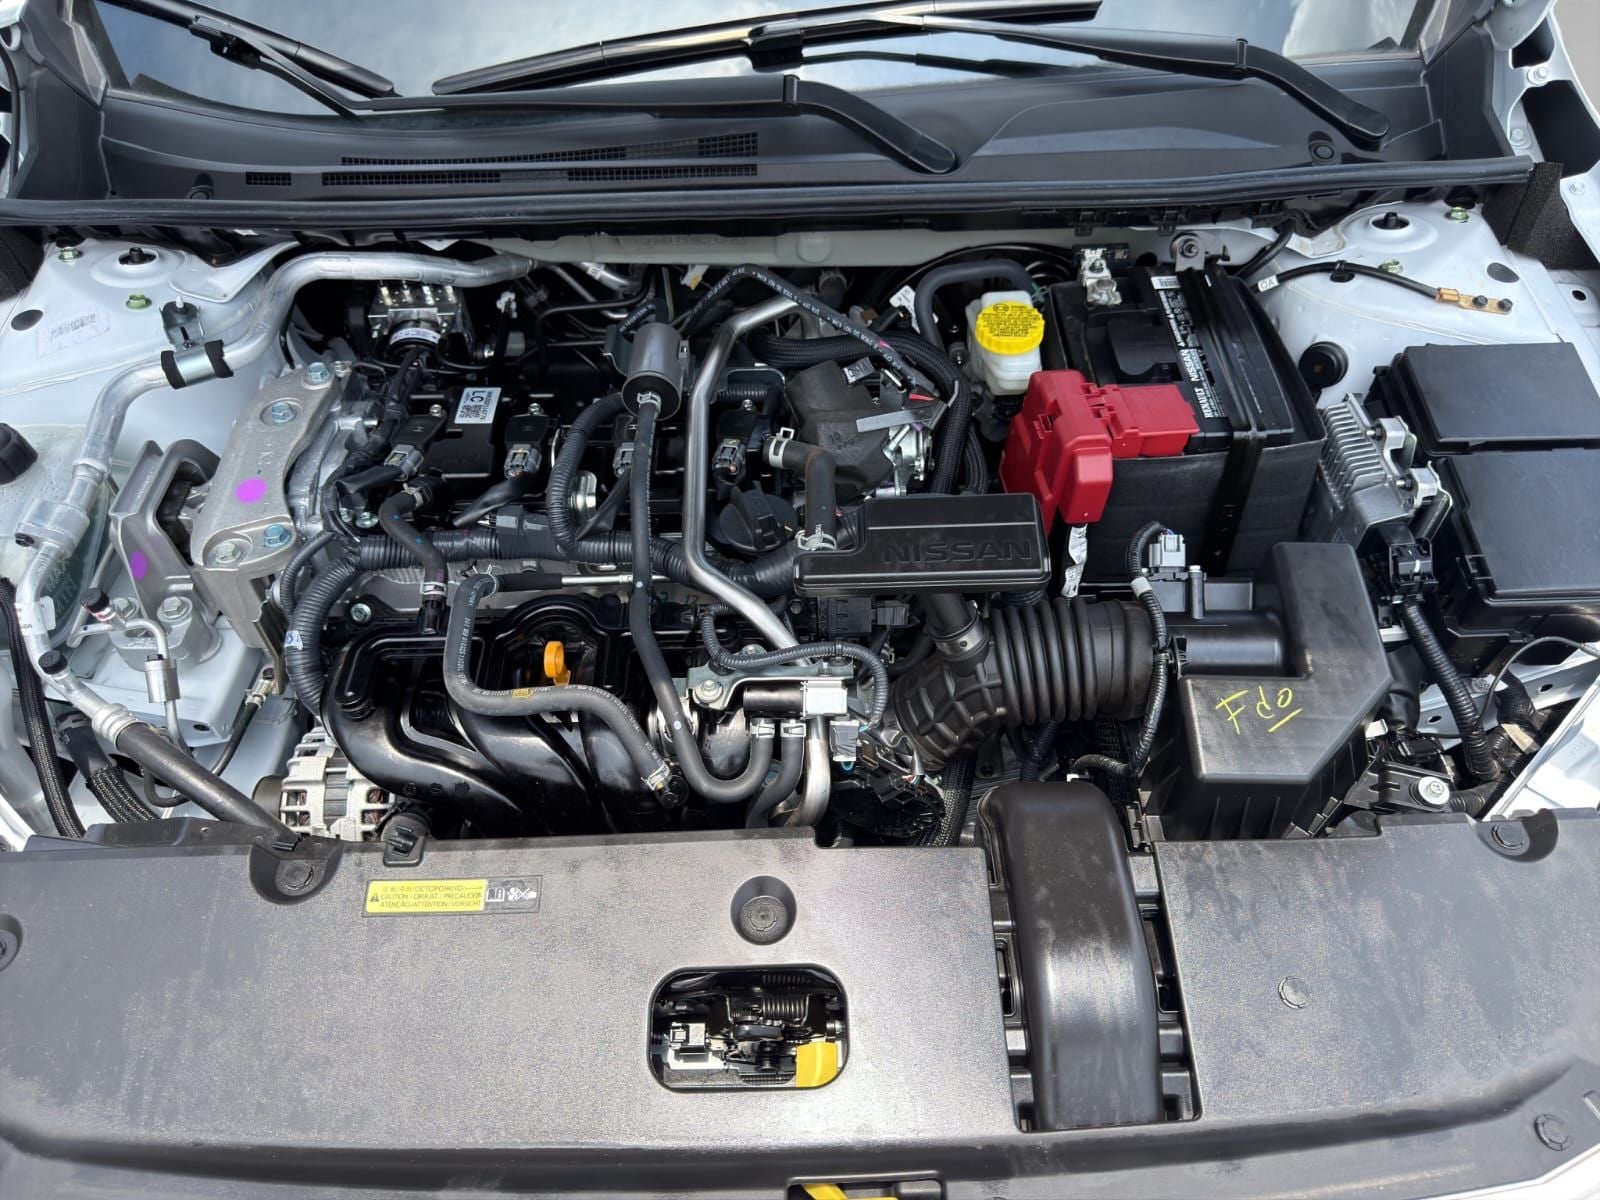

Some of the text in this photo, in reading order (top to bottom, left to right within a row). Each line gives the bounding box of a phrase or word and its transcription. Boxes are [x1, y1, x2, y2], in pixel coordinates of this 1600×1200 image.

[1180, 349, 1200, 382] NISSAN
[1195, 386, 1214, 418] RENAULT
[881, 540, 1033, 564] NISSAN
